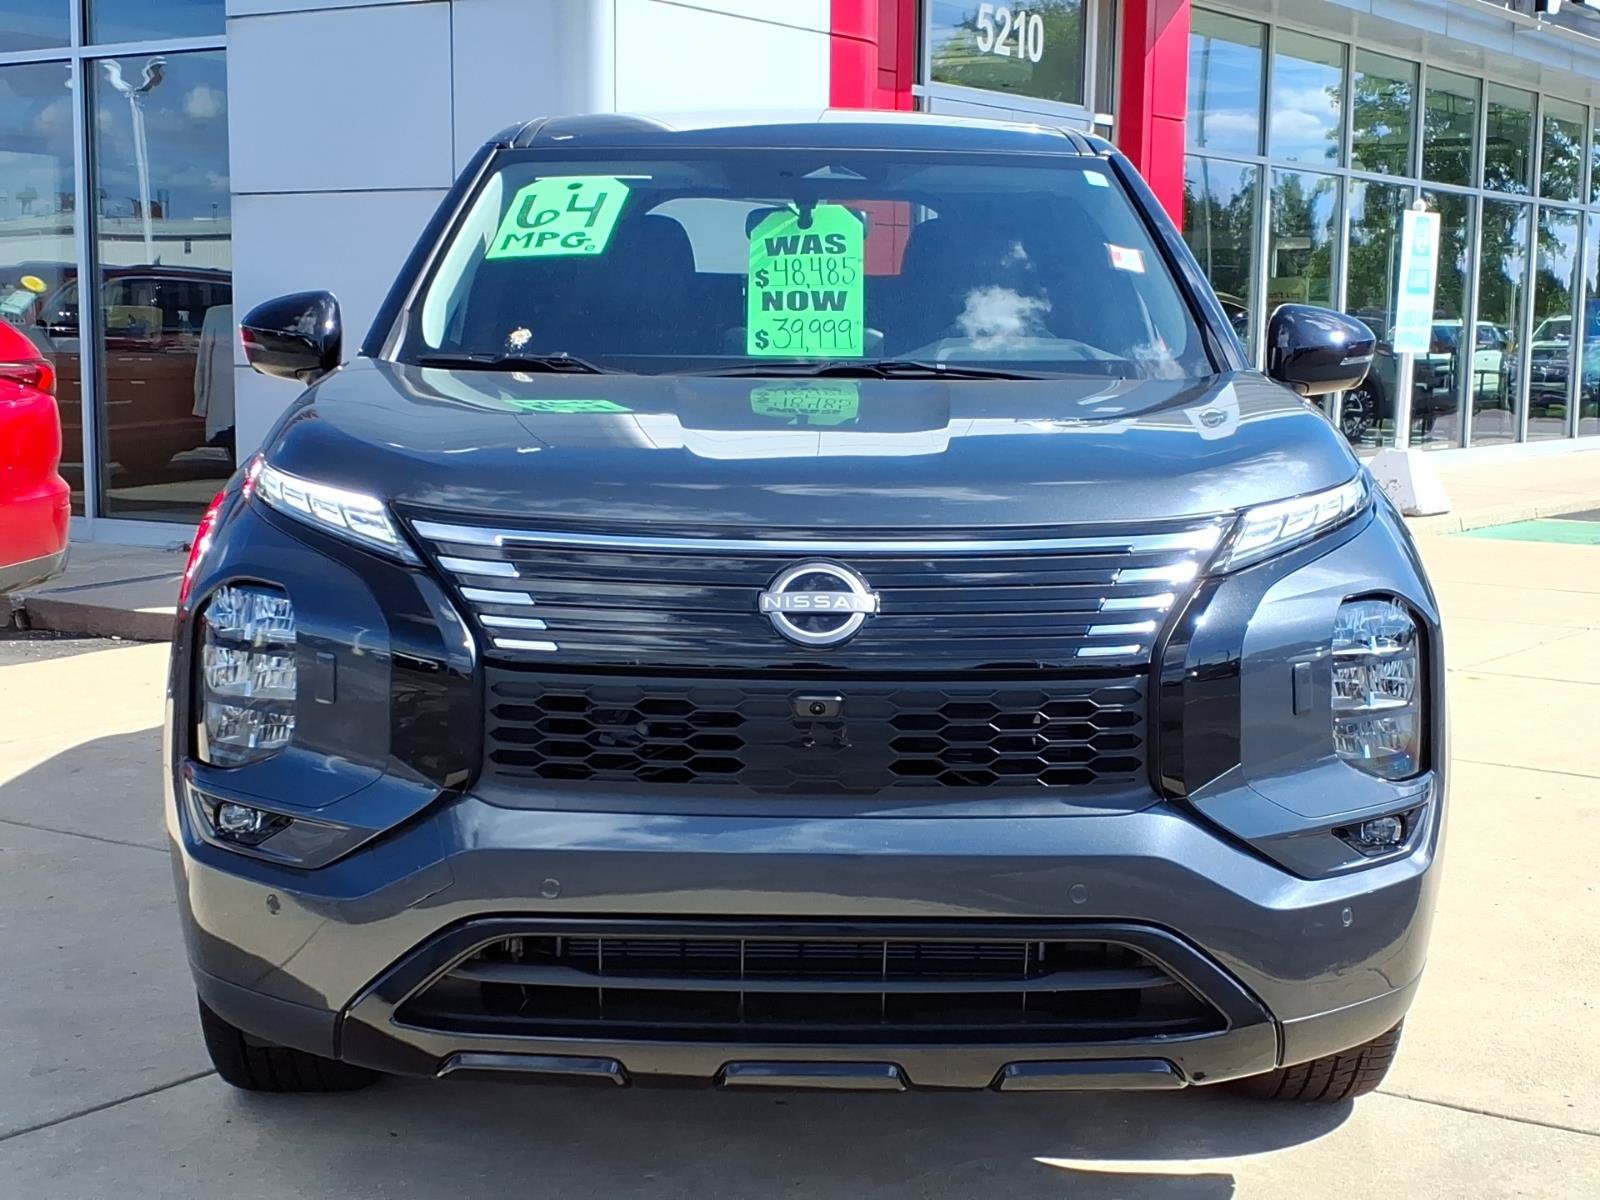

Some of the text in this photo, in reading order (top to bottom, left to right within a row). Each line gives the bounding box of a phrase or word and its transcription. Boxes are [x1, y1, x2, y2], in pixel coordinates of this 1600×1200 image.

[976, 3, 1044, 62] 5210
[516, 192, 608, 228] 64
[764, 233, 847, 257] WAS
[761, 290, 848, 312] NOW
